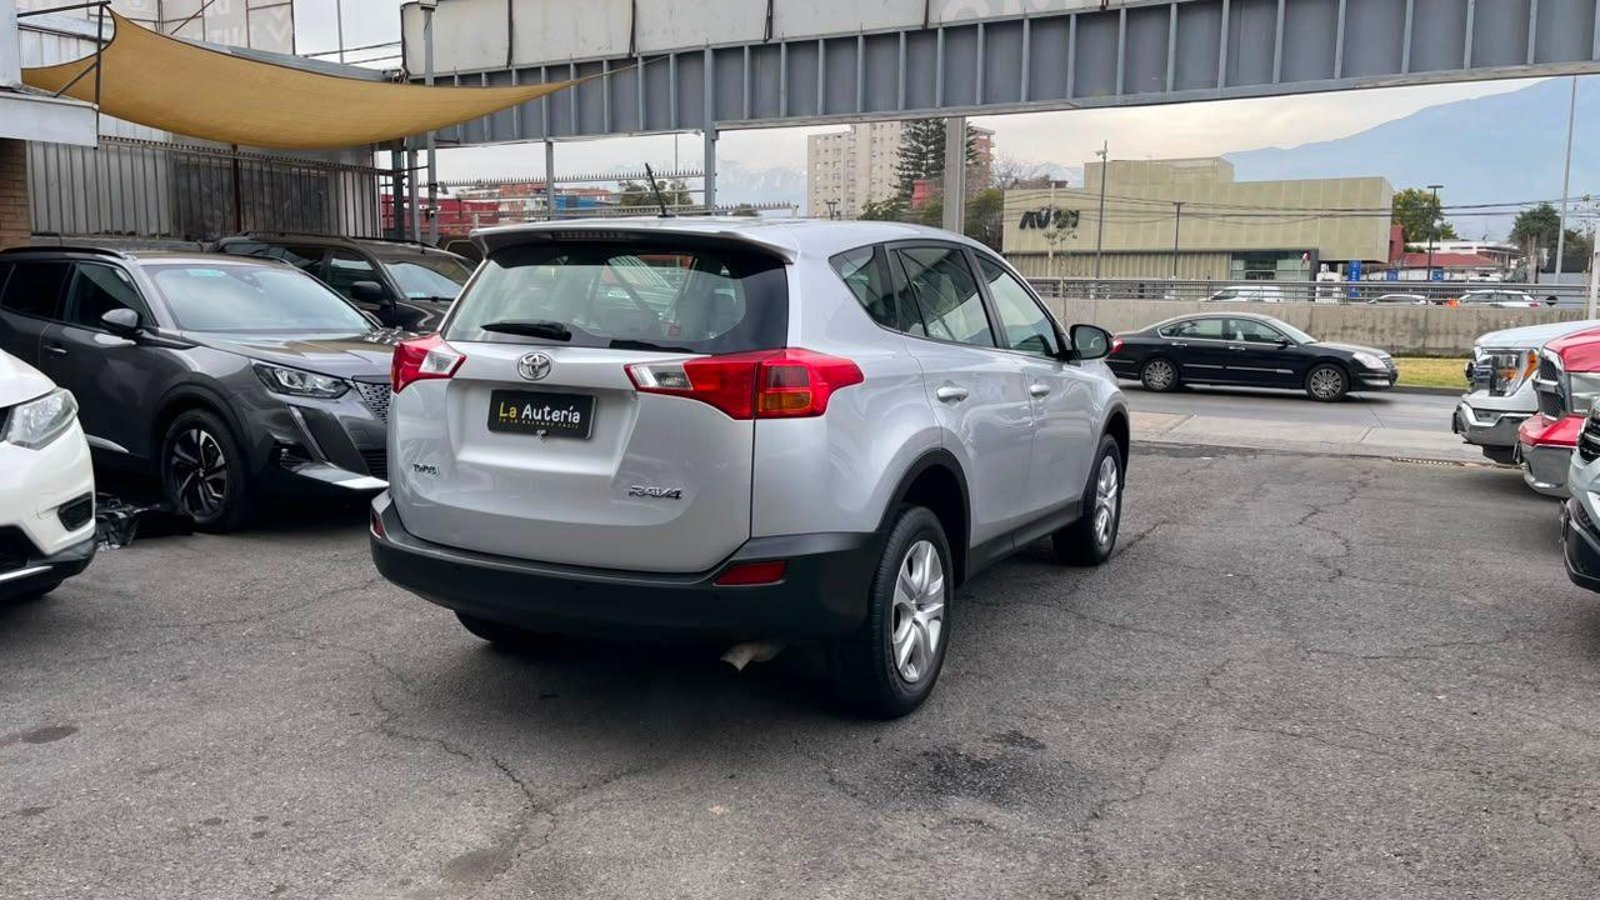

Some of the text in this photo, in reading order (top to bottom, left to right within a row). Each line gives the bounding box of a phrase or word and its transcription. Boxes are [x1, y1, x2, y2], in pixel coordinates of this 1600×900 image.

[499, 402, 581, 423] La Autería
[628, 484, 682, 500] RAV4
